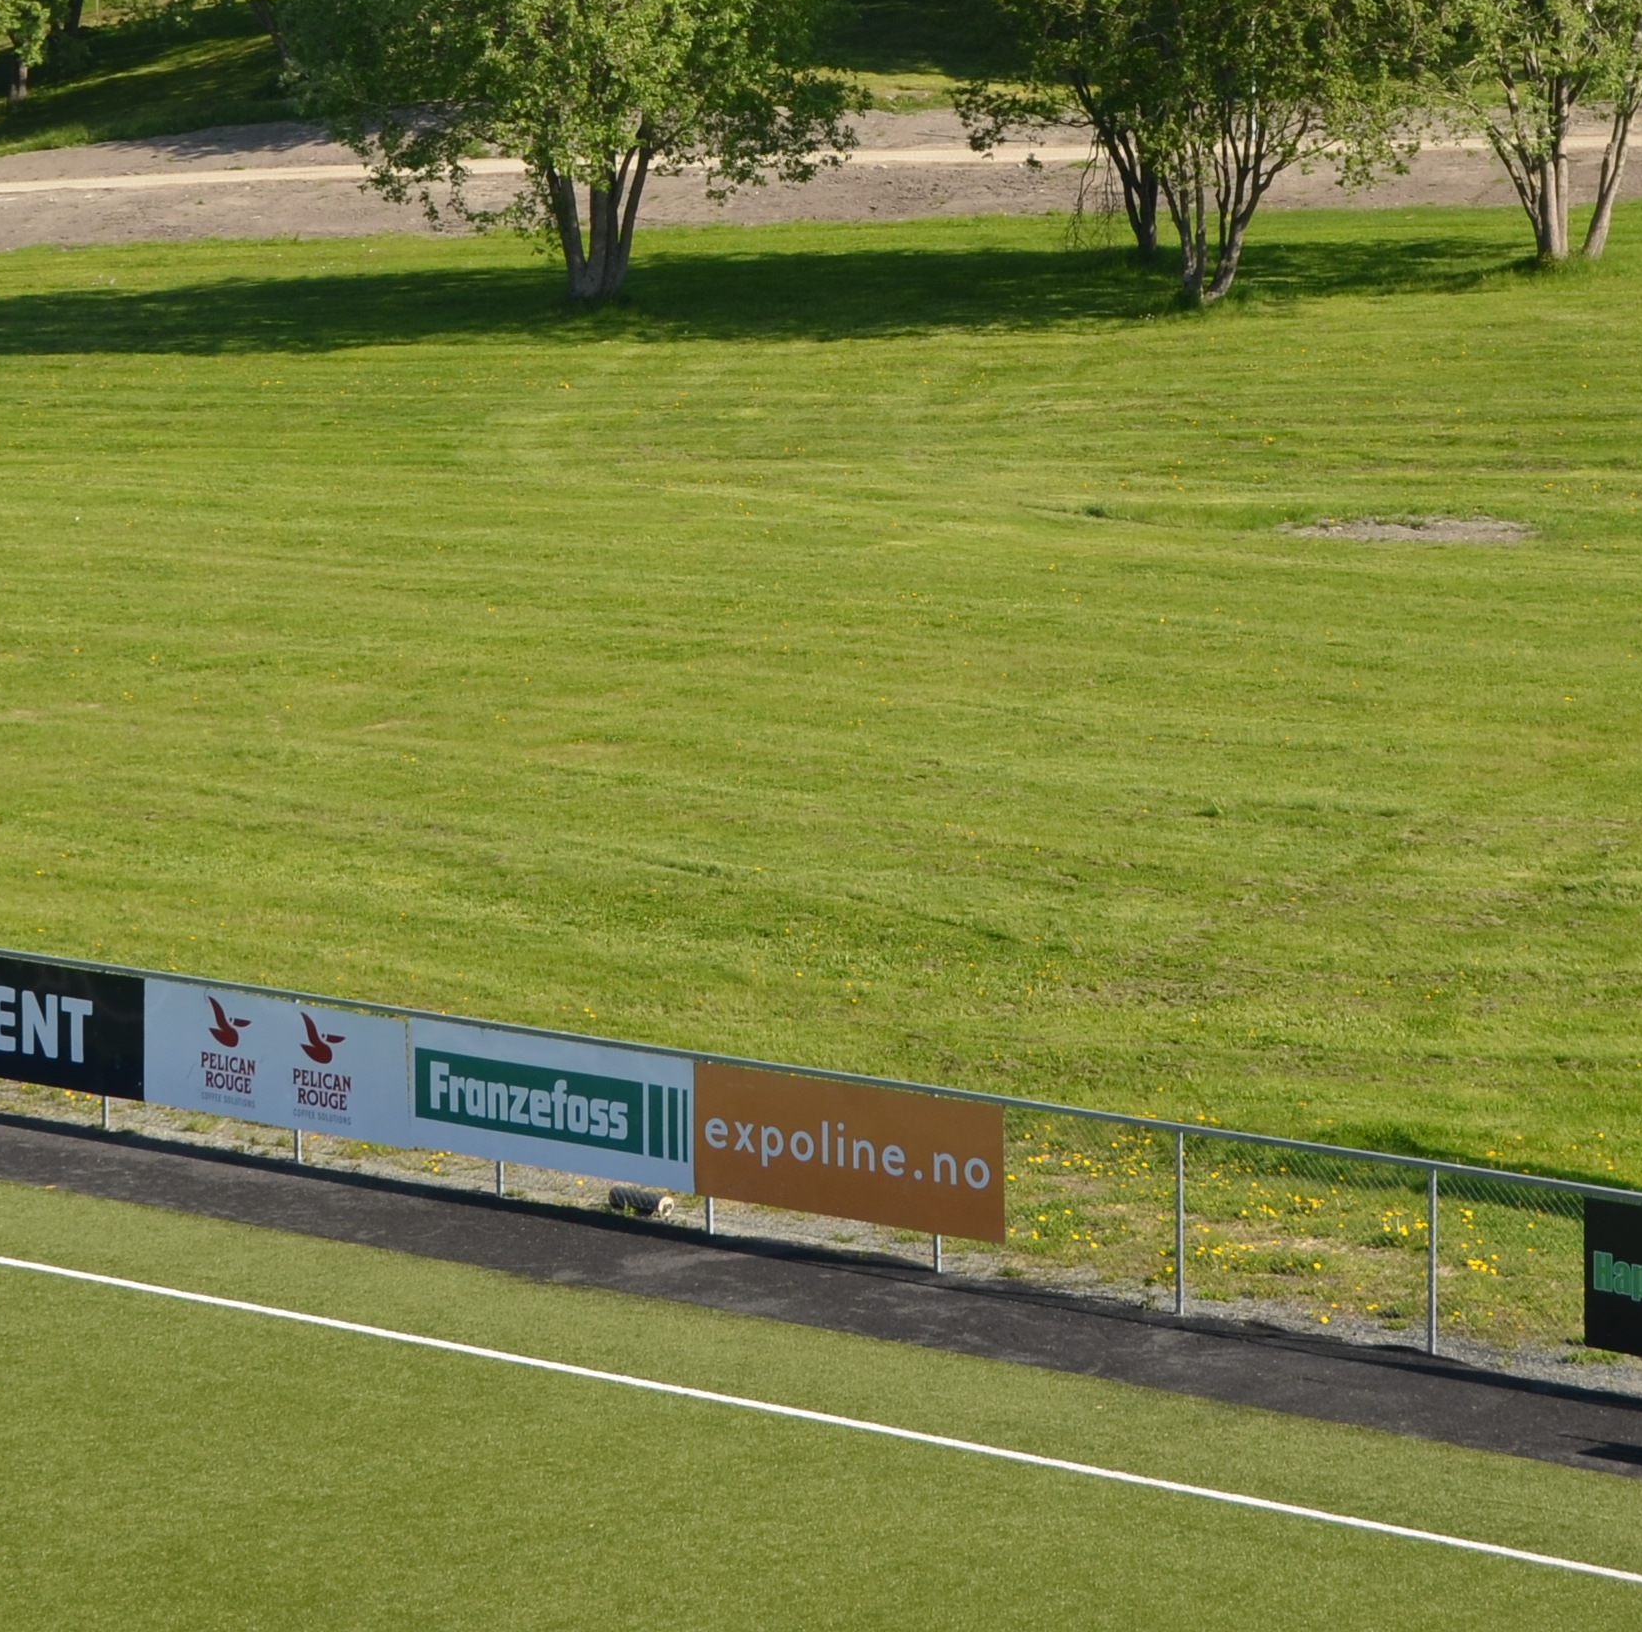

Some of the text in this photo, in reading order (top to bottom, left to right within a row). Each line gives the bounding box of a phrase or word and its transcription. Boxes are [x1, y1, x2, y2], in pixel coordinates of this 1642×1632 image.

[200, 1051, 256, 1076] PELICAN
[205, 1070, 252, 1094] ROUGE
[292, 1068, 351, 1093] PELICAN
[201, 1091, 256, 1109] COFFEE SOLUTIONS
[297, 1088, 348, 1111] ROUGE
[430, 1061, 629, 1141] Franzefoss
[293, 1108, 352, 1126] COFFEE SOLUTIONS
[704, 1117, 991, 1190] expoline.no
